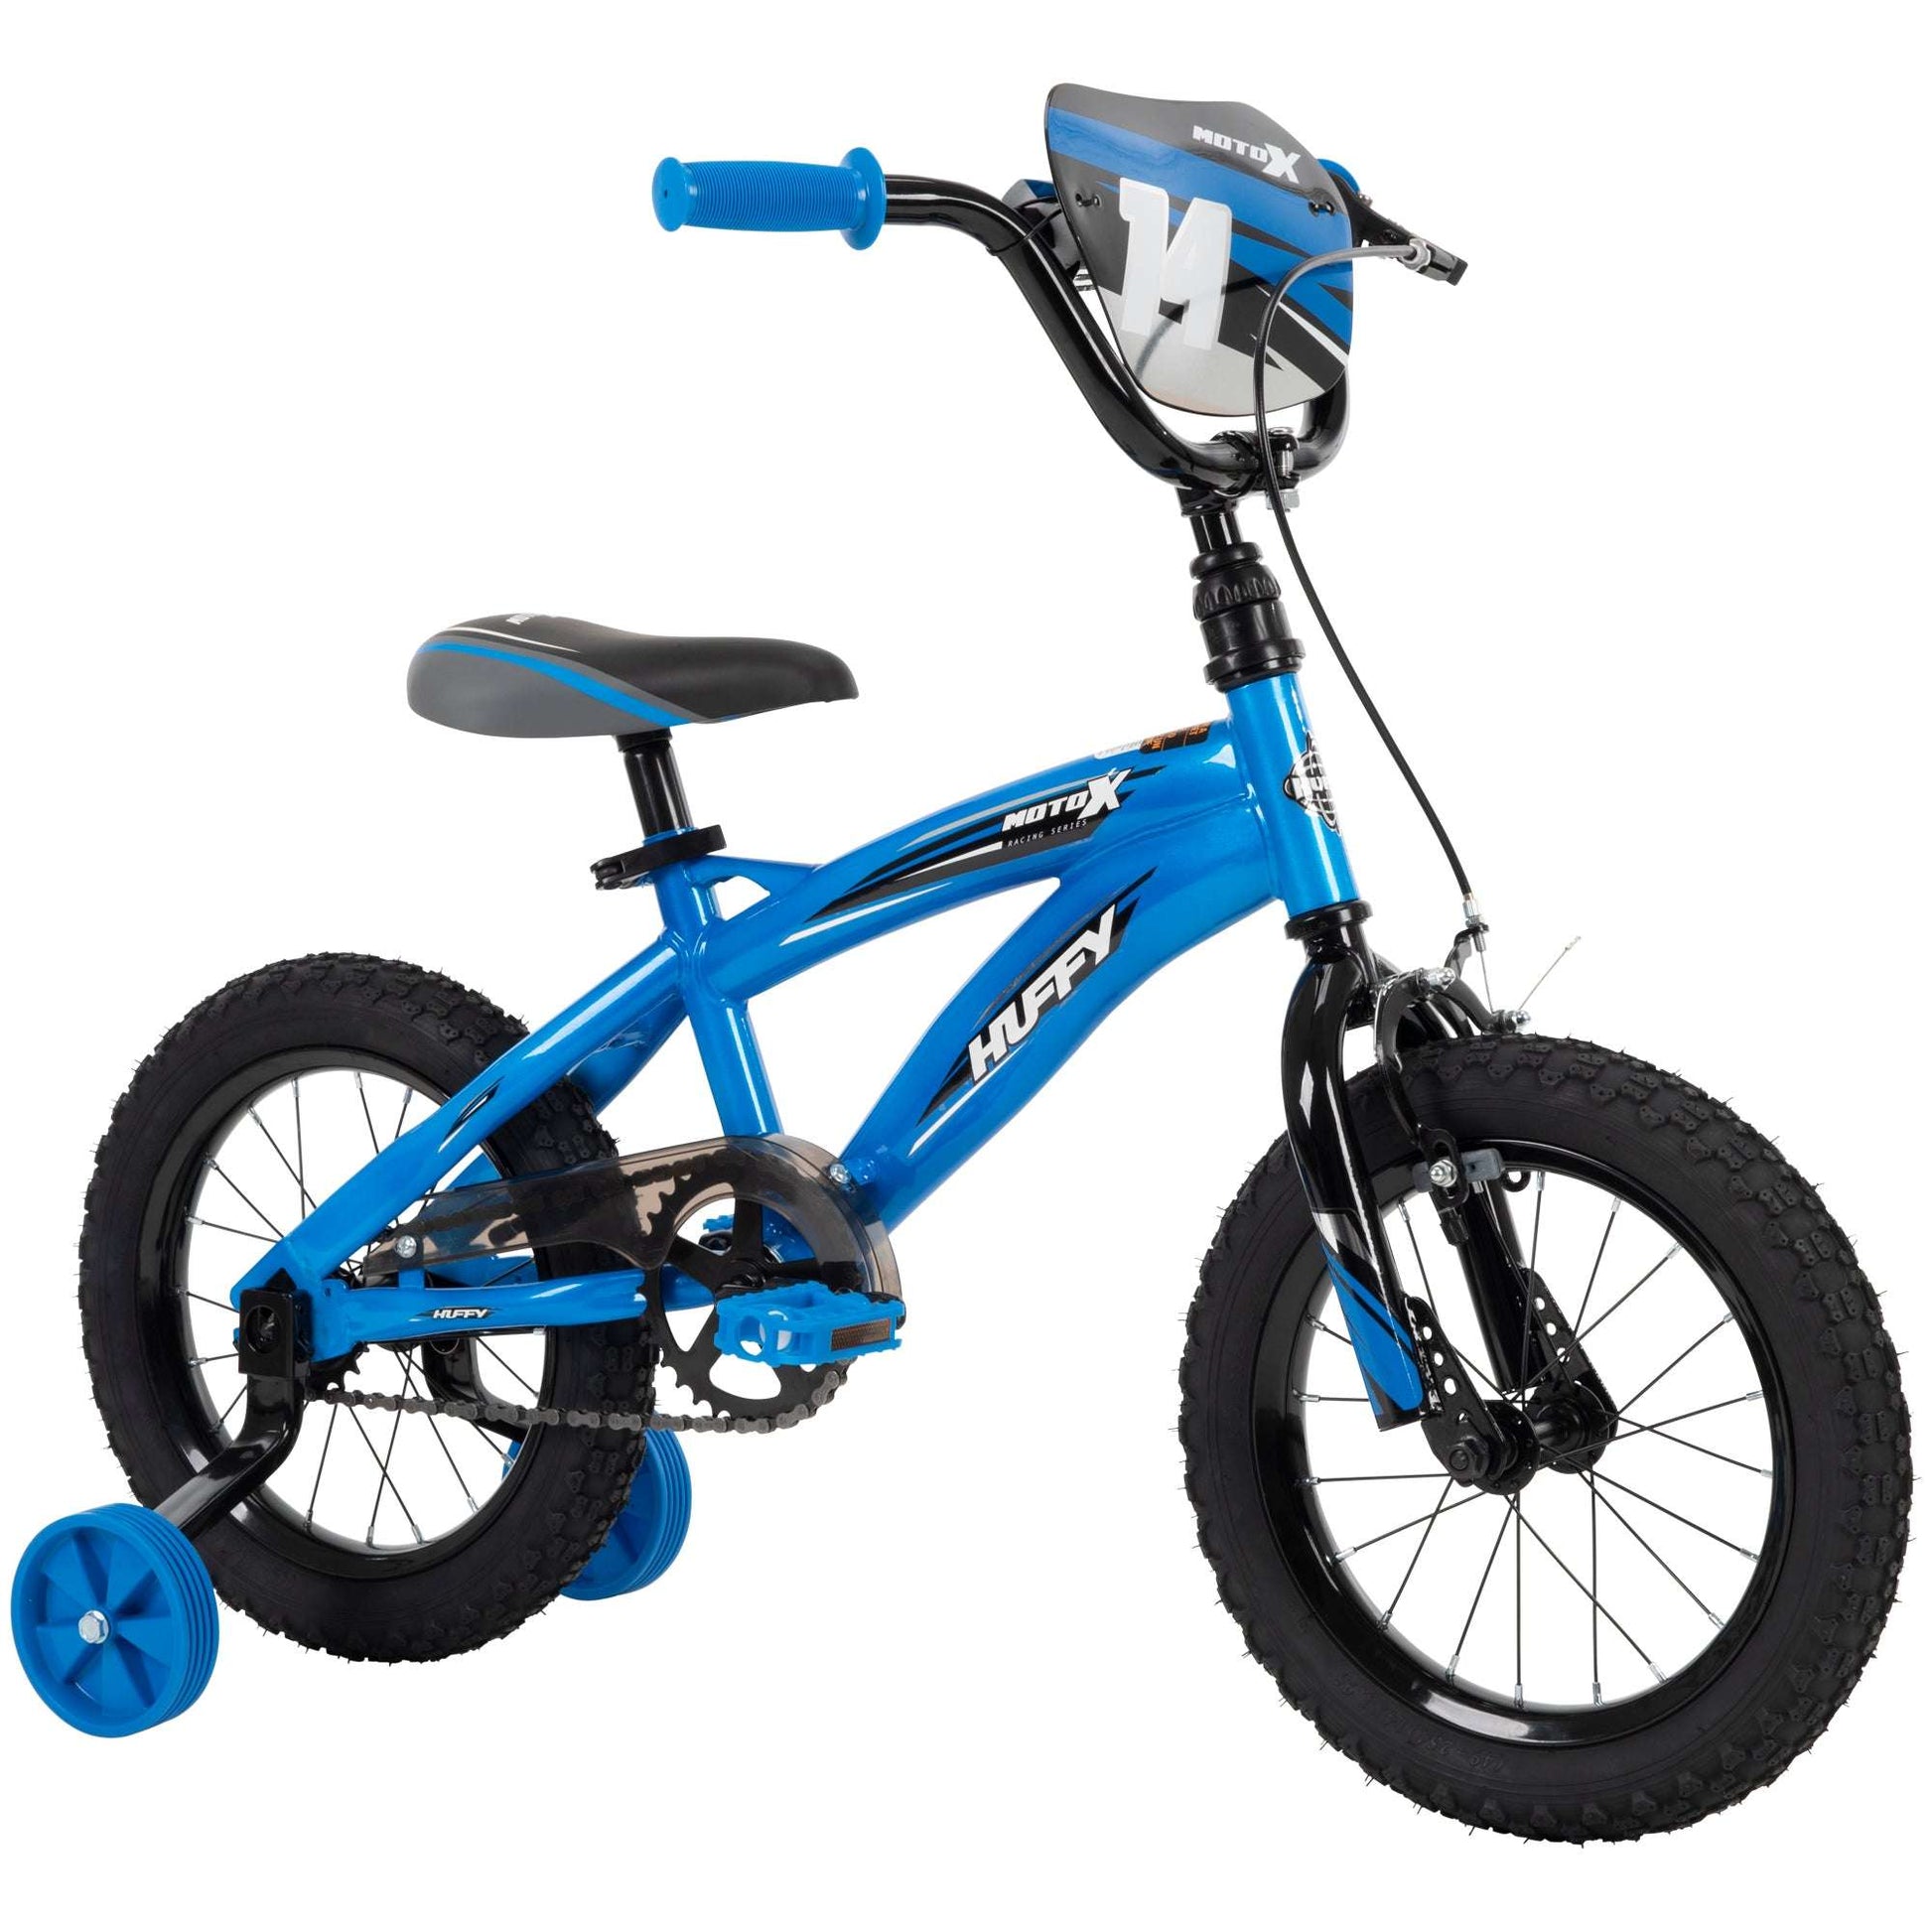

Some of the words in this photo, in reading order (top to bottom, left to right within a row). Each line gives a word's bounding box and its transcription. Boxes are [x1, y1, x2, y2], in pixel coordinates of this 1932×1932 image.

[1118, 177, 1233, 351] 14
[1007, 831, 1044, 848] RACING
[1050, 818, 1088, 836] SERIES
[968, 903, 1116, 1082] HUFFY
[433, 1309, 488, 1319] HUFFY
